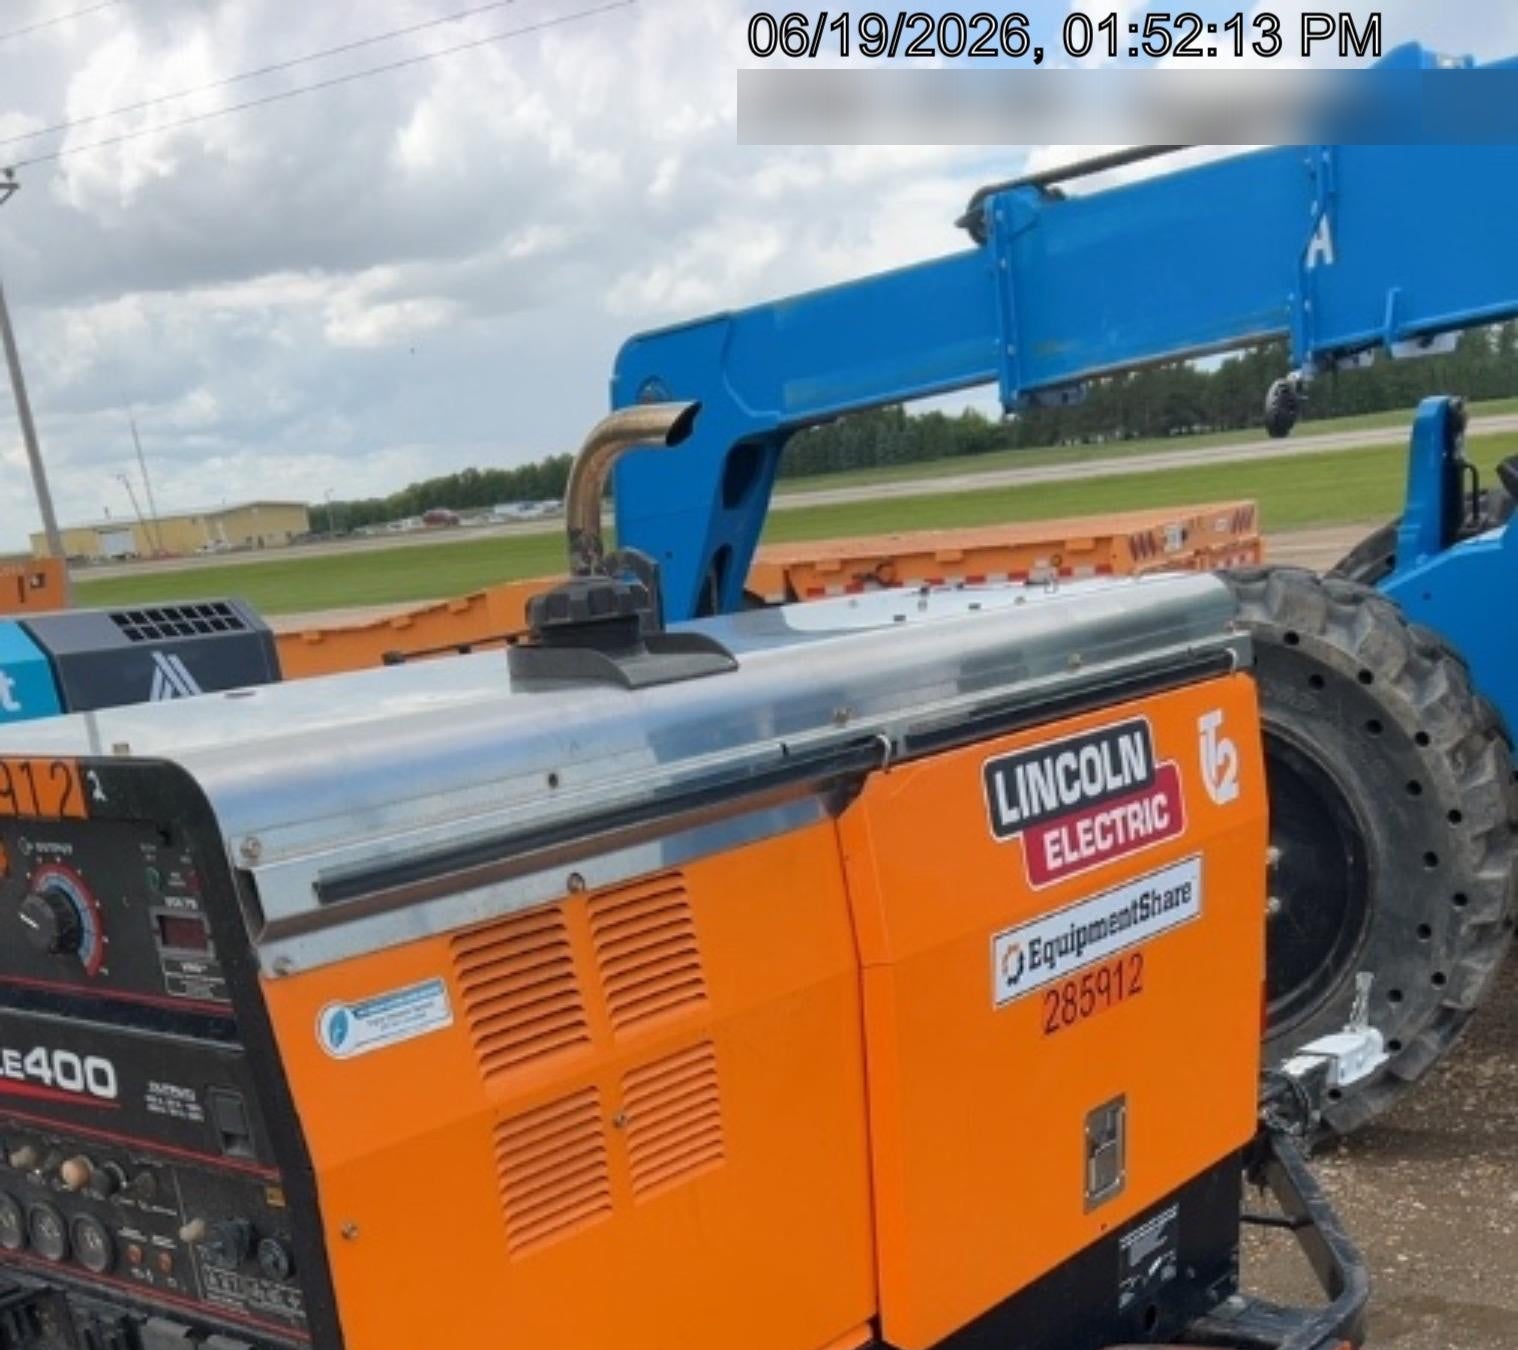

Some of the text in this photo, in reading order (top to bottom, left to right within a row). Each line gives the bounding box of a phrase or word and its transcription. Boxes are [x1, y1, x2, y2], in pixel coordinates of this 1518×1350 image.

[994, 730, 1149, 826] LINCOLN
[1042, 793, 1171, 871] ELECTRIC
[1027, 881, 1193, 974] EquipmentShare
[1043, 952, 1144, 1037] 285912
